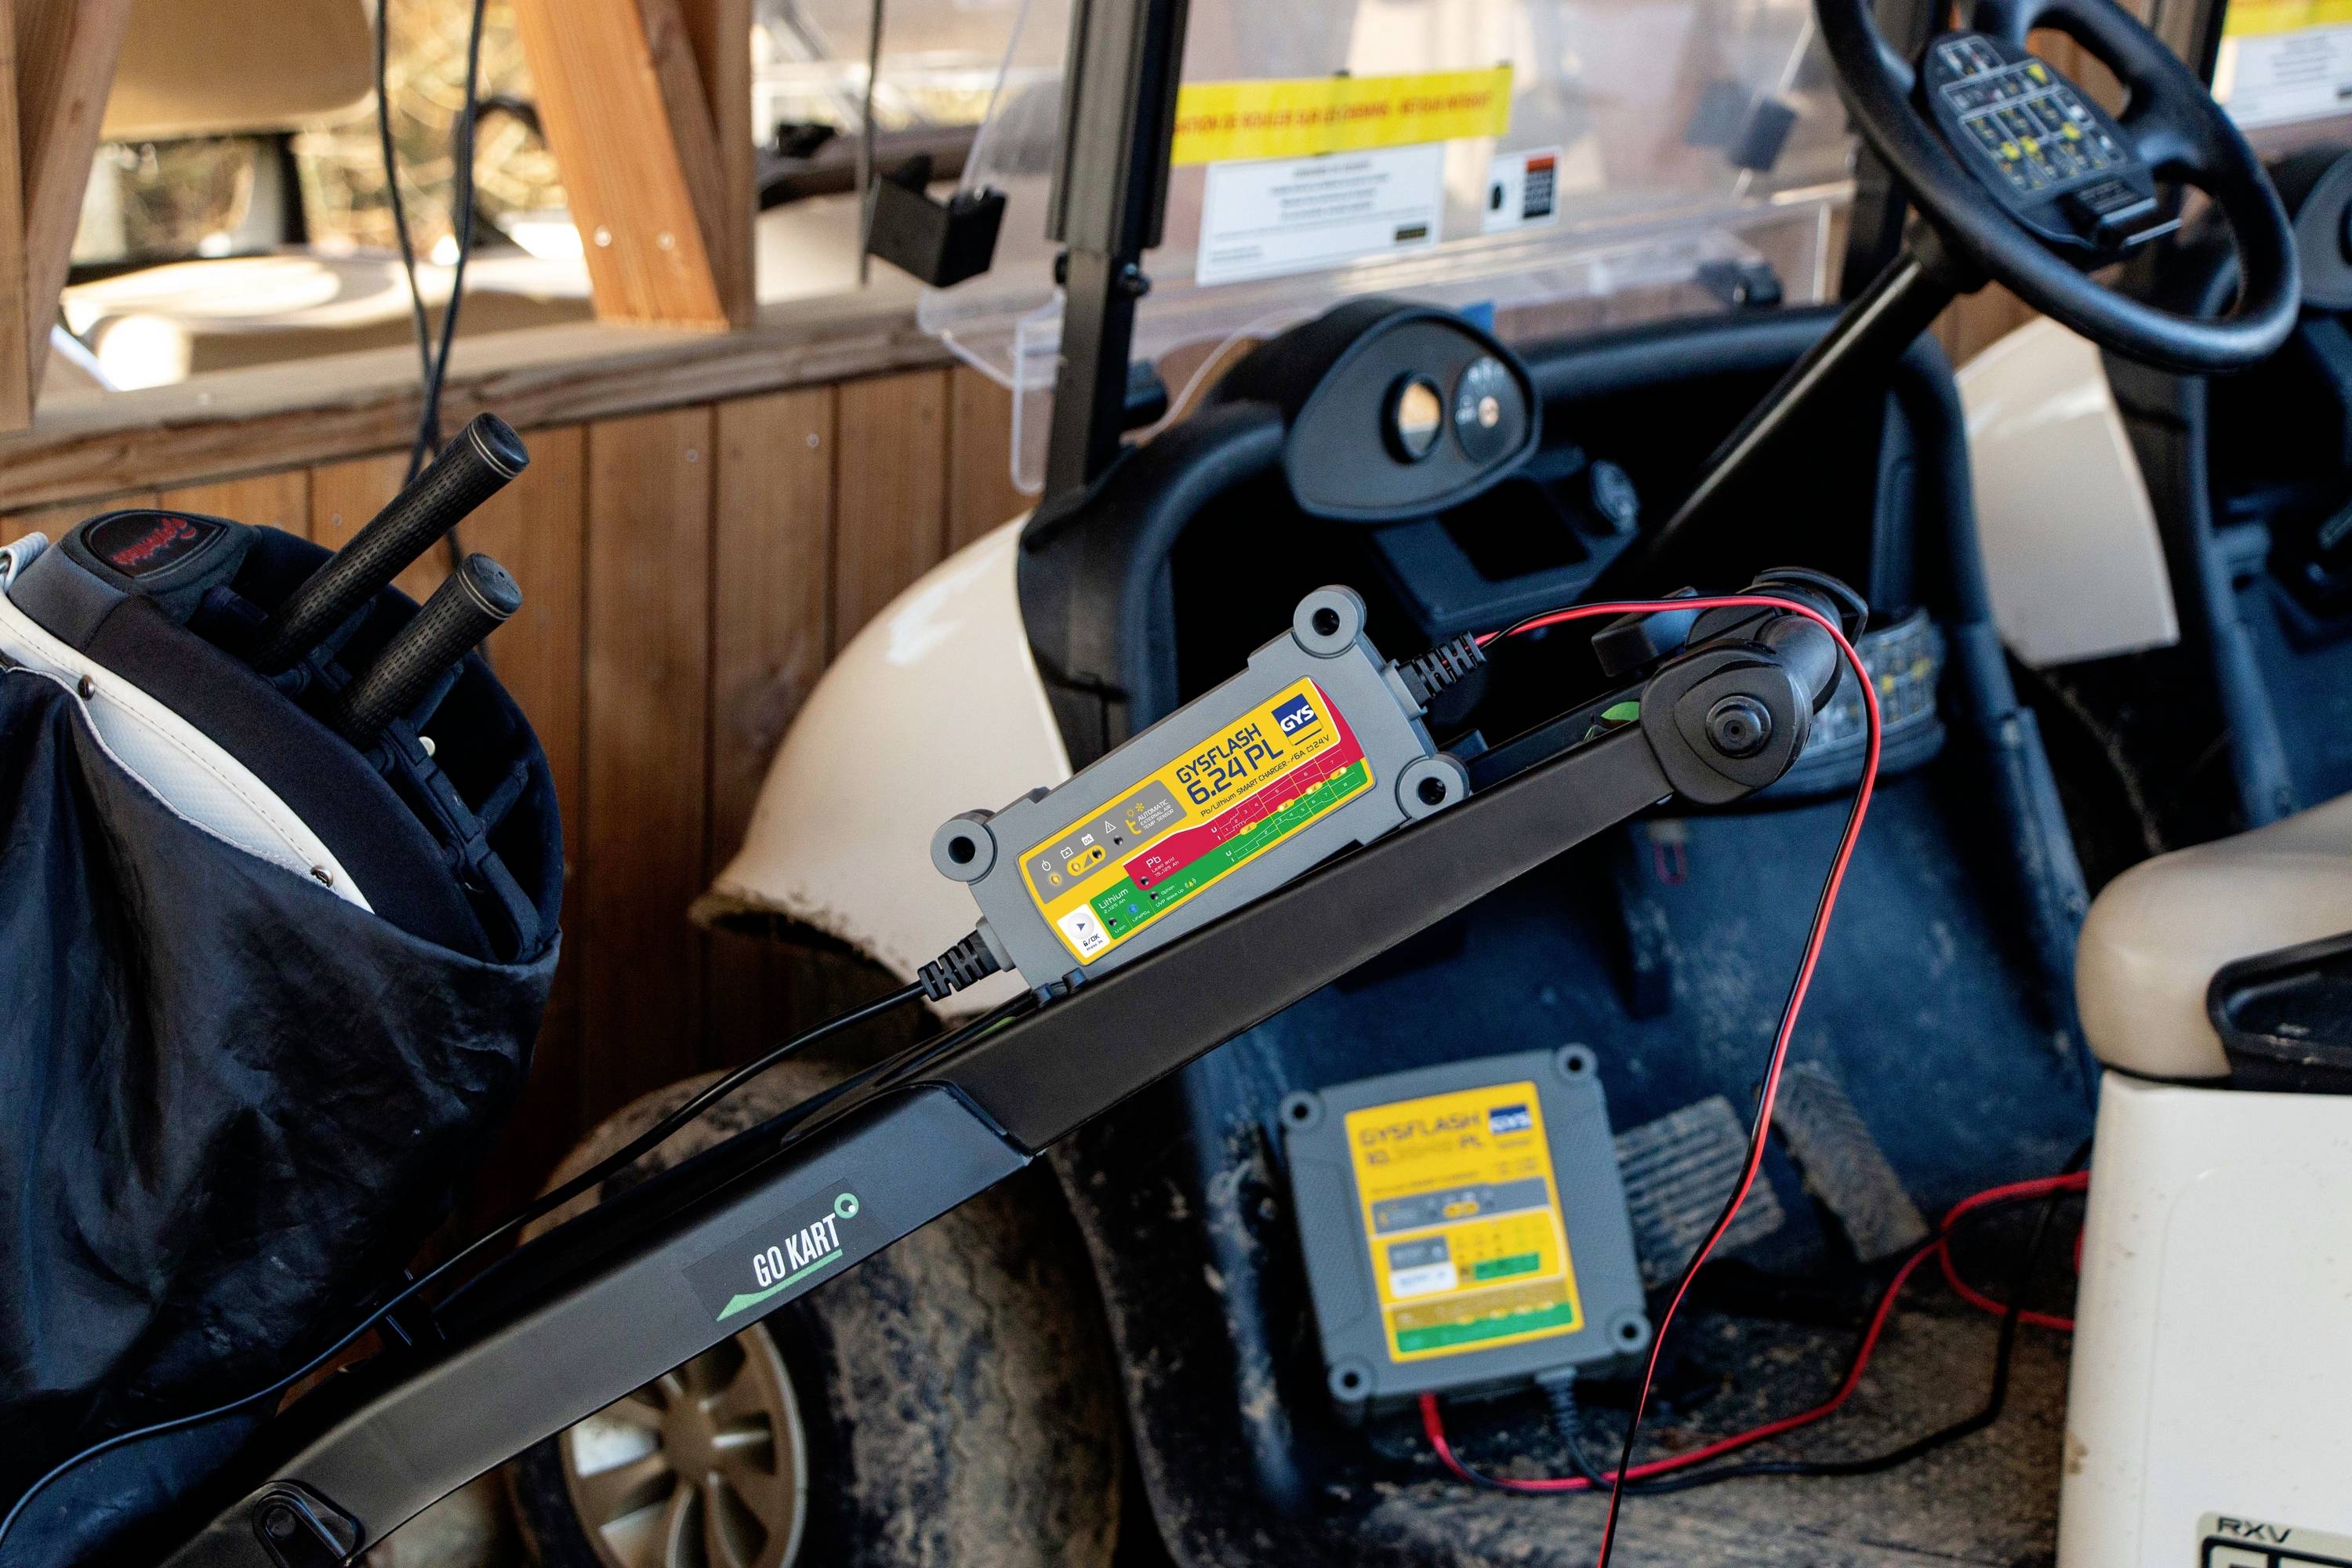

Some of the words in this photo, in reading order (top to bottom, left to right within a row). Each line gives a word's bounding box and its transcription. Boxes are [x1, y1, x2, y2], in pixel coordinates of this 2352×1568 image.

[1280, 704, 1315, 731] GYS
[1175, 722, 1262, 784] GYSFLASH
[1186, 756, 1248, 805] 6.24
[1243, 739, 1284, 771] PL
[1200, 793, 1237, 818] Pb/Lithium
[1236, 778, 1258, 796] SMART
[1258, 760, 1287, 782] CHARGER
[1138, 798, 1170, 822] AUTOMATIC
[1139, 808, 1165, 827] EXTERNAL
[1162, 803, 1173, 813] AIR
[1142, 819, 1156, 830] TEMP
[1155, 808, 1174, 822] SENSOR
[1145, 855, 1162, 869] Pb
[1150, 862, 1164, 873] Lead
[1163, 856, 1175, 866] acid
[1098, 888, 1129, 909] Lithium
[1160, 884, 1175, 896] Option
[1155, 898, 1166, 908] UVP
[1359, 1112, 1481, 1147] GYSFLASH
[753, 1246, 786, 1287] GO
[785, 1212, 840, 1270] KART
[2218, 1516, 2292, 1543] RXV
